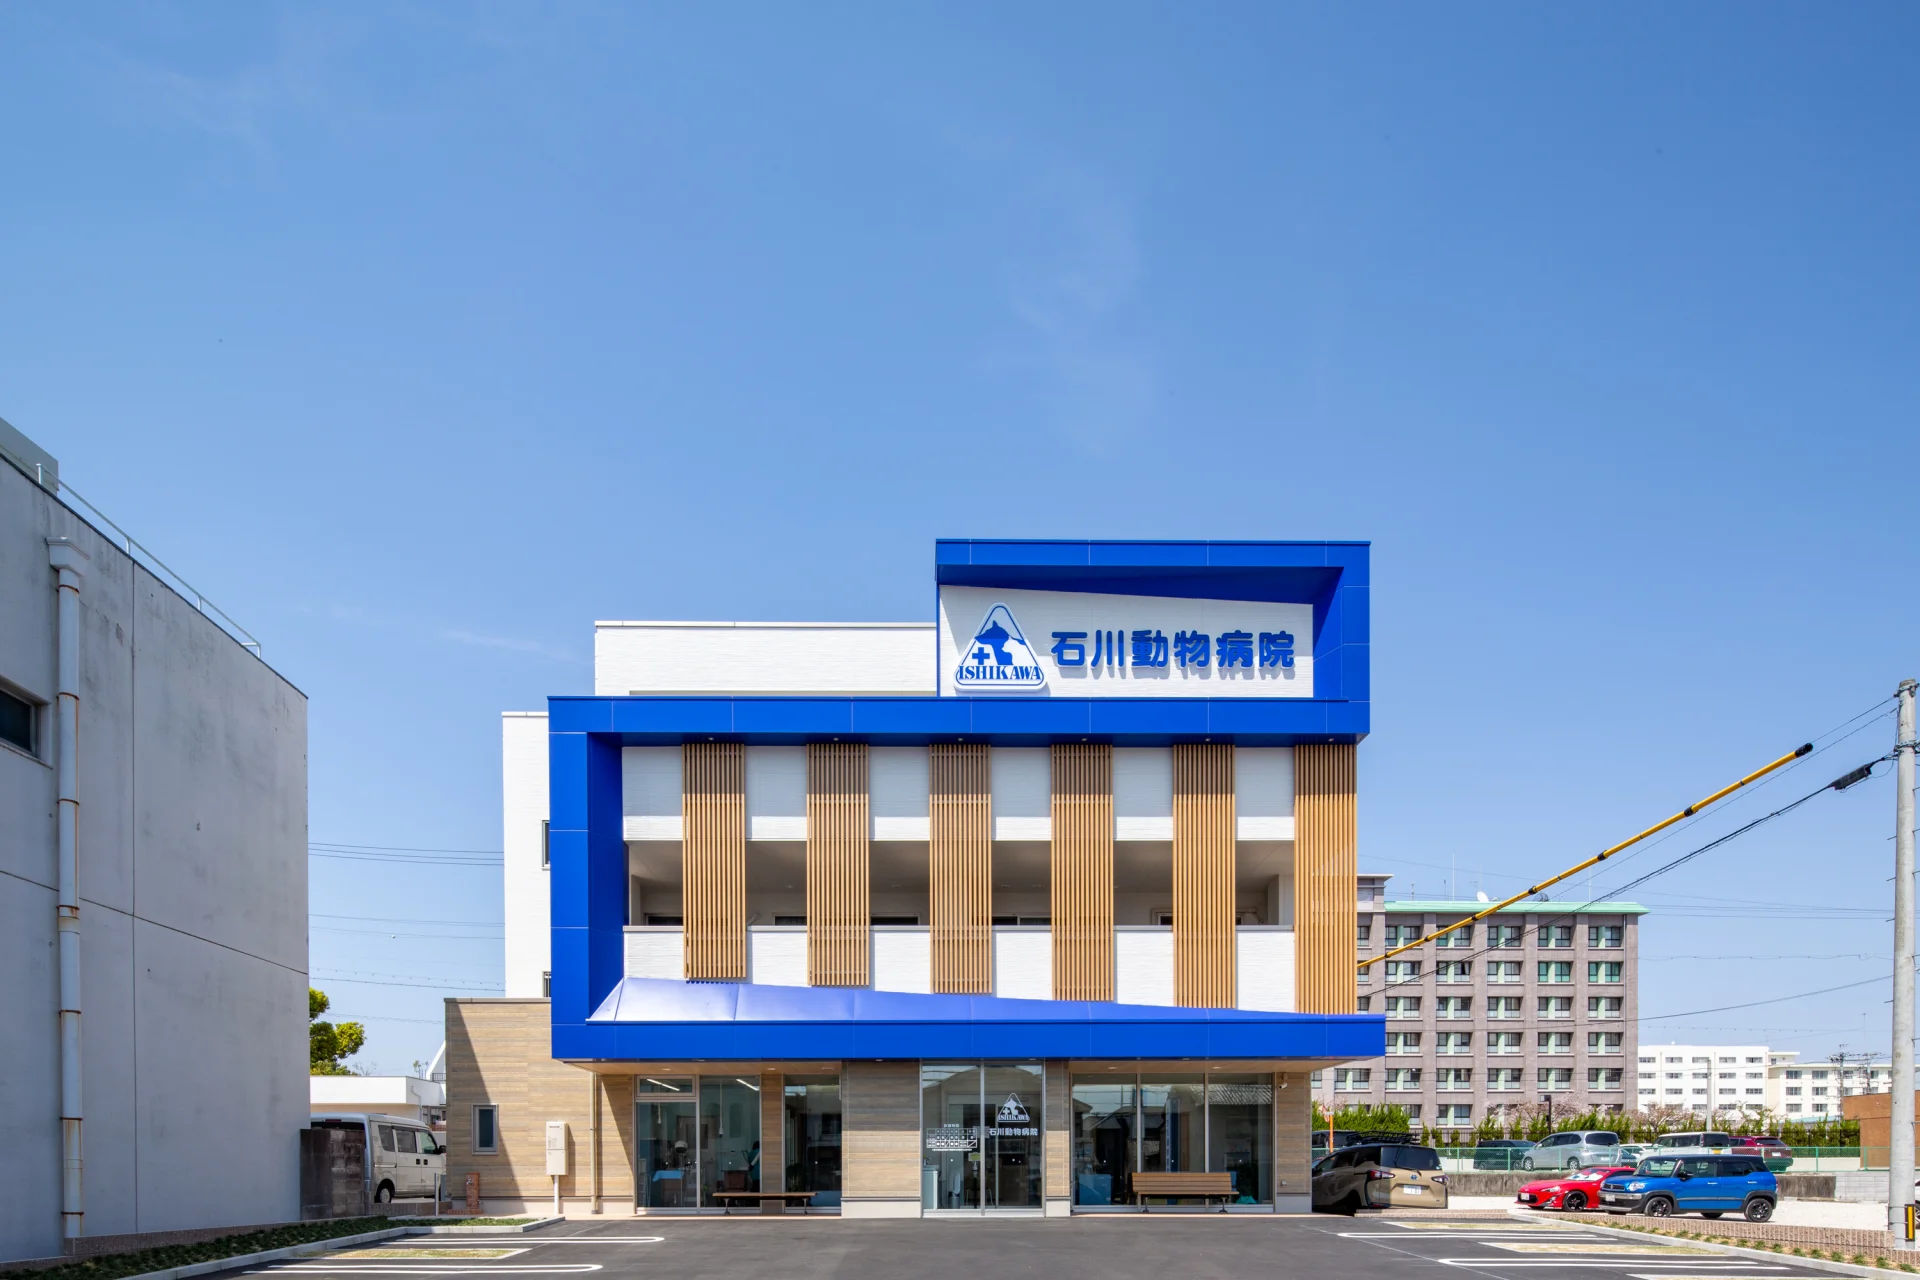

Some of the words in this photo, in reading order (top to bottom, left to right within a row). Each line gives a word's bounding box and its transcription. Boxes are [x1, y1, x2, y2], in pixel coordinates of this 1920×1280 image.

[1051, 630, 1295, 668] 石川動物病院
[958, 665, 1041, 680] ISHIKAWA
[989, 1127, 1038, 1136] 石川動物病院
